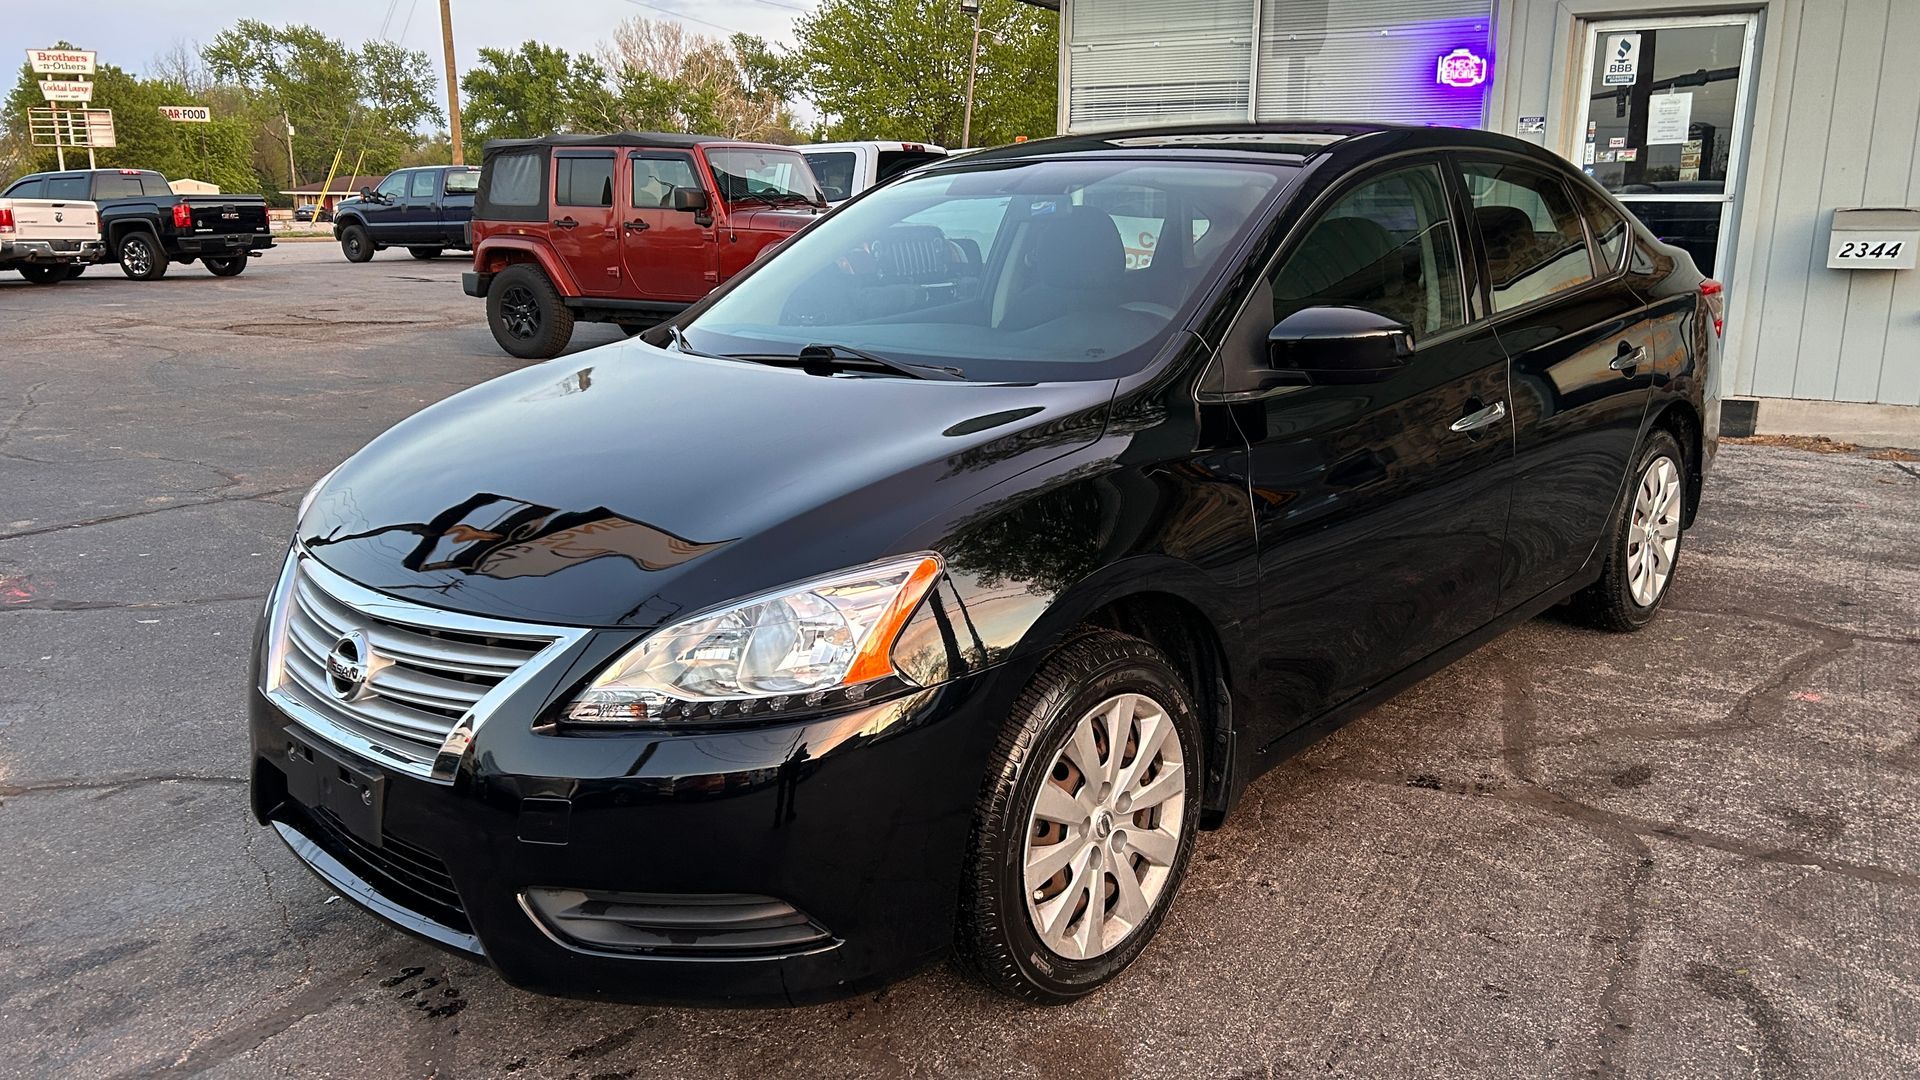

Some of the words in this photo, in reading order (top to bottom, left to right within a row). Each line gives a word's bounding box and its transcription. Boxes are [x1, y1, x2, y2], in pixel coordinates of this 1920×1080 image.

[37, 52, 88, 62] Brothers
[1444, 59, 1476, 69] CHECK
[1609, 64, 1632, 73] BBB
[1444, 69, 1478, 80] ENGINE
[43, 83, 68, 92] Cocktail
[69, 84, 90, 94] Lounge
[1839, 242, 1902, 258] 2344
